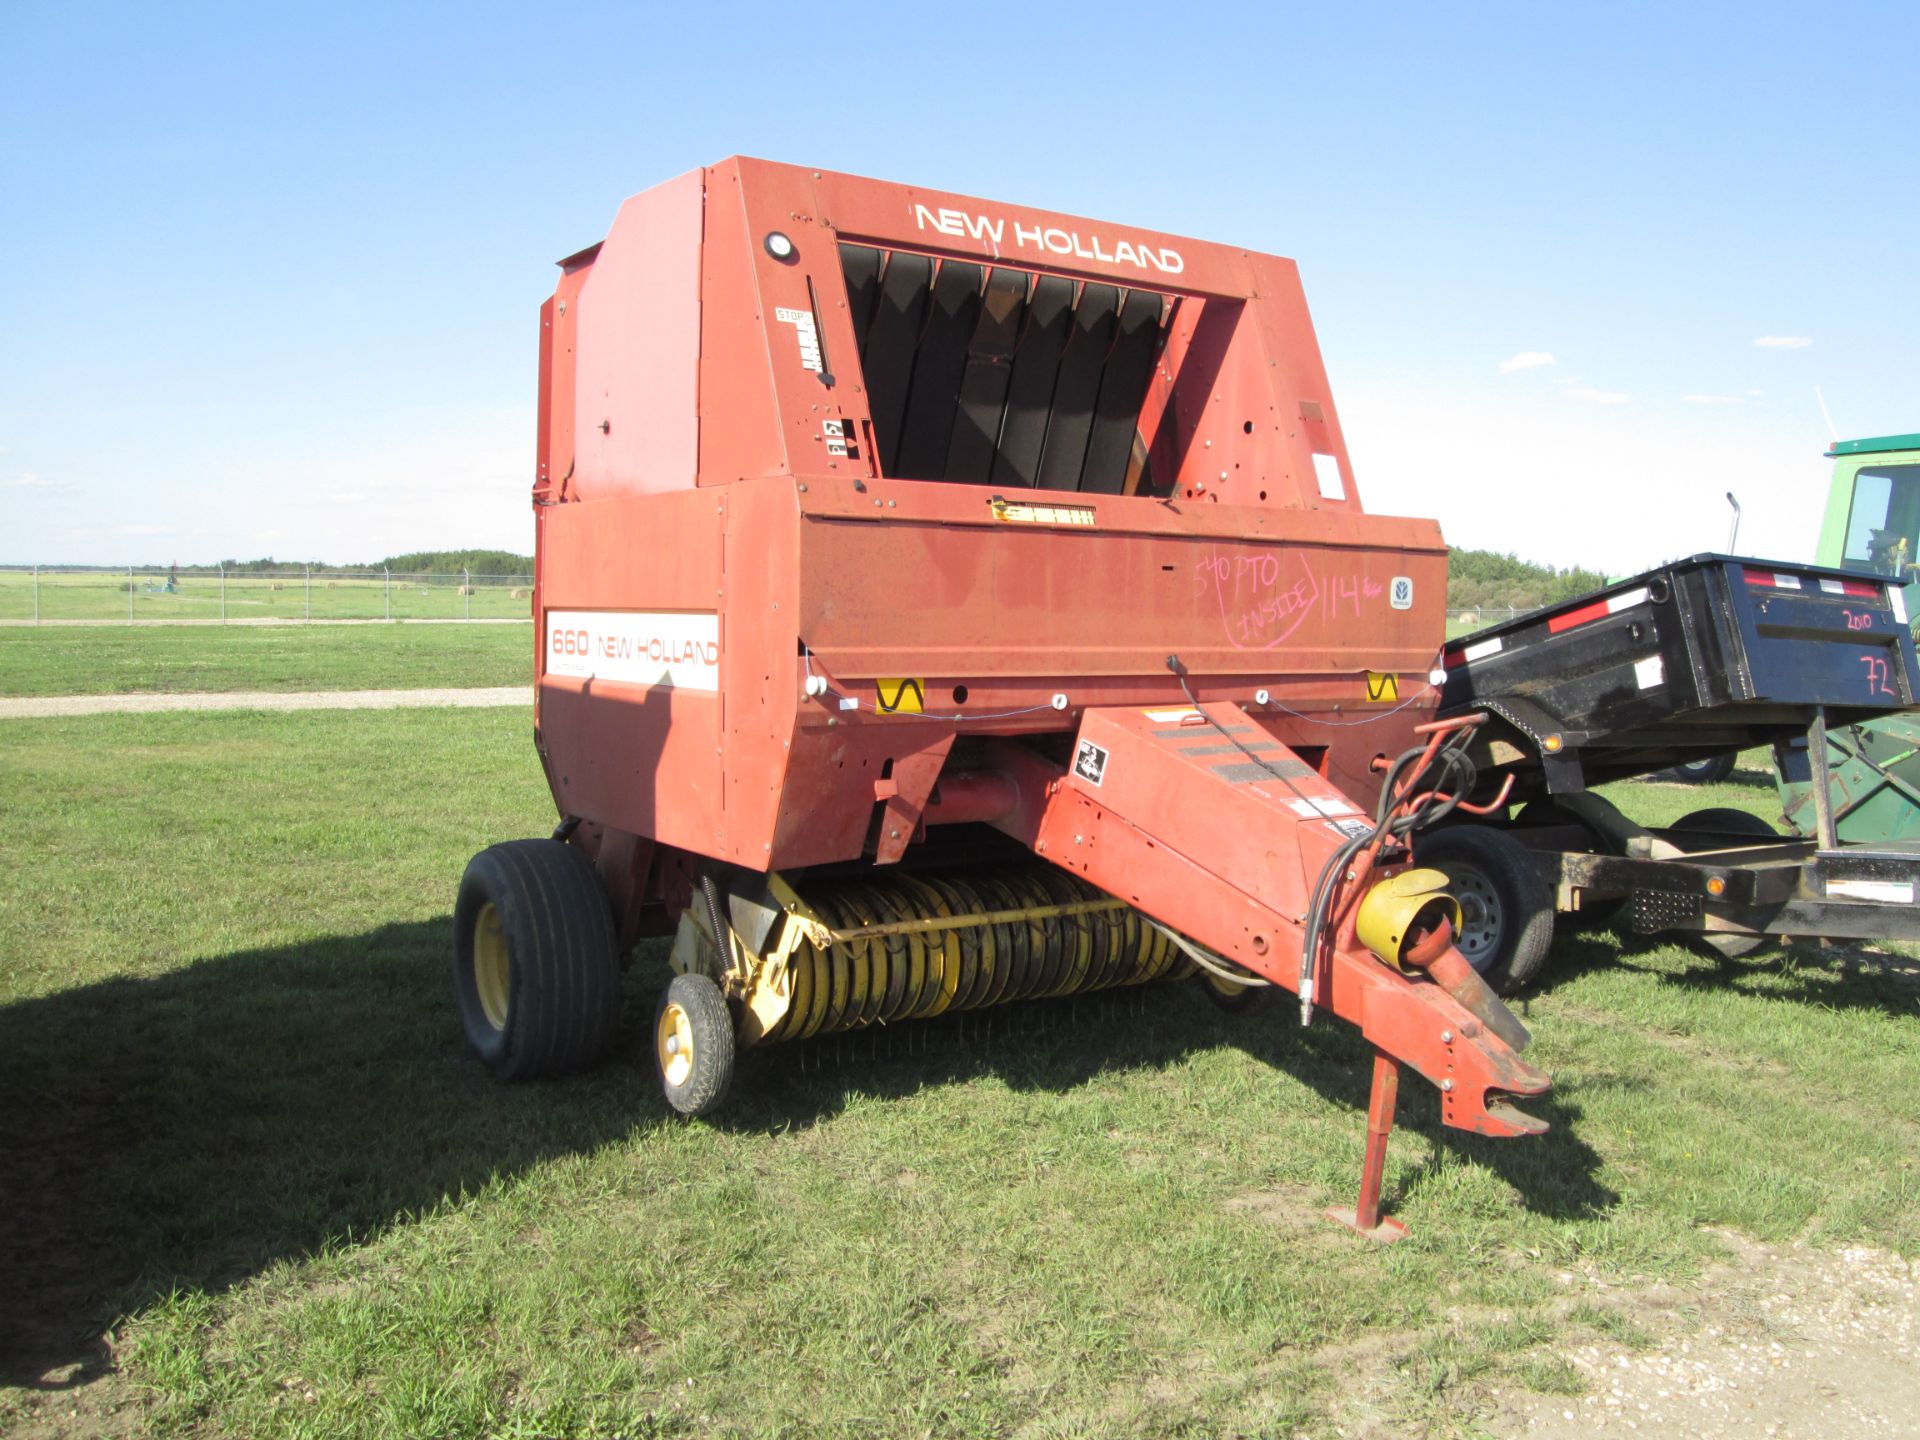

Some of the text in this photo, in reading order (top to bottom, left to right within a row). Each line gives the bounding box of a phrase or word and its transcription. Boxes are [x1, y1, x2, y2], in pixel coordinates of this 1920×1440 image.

[915, 203, 1184, 274] NEW HOLLAND
[777, 309, 804, 321] STOP
[1234, 553, 1279, 601] PTO
[1236, 578, 1310, 641] INSIDE
[1842, 609, 1872, 631] 2010
[552, 628, 719, 666] 660 NEW HOLLAND
[1859, 655, 1895, 696] 72
